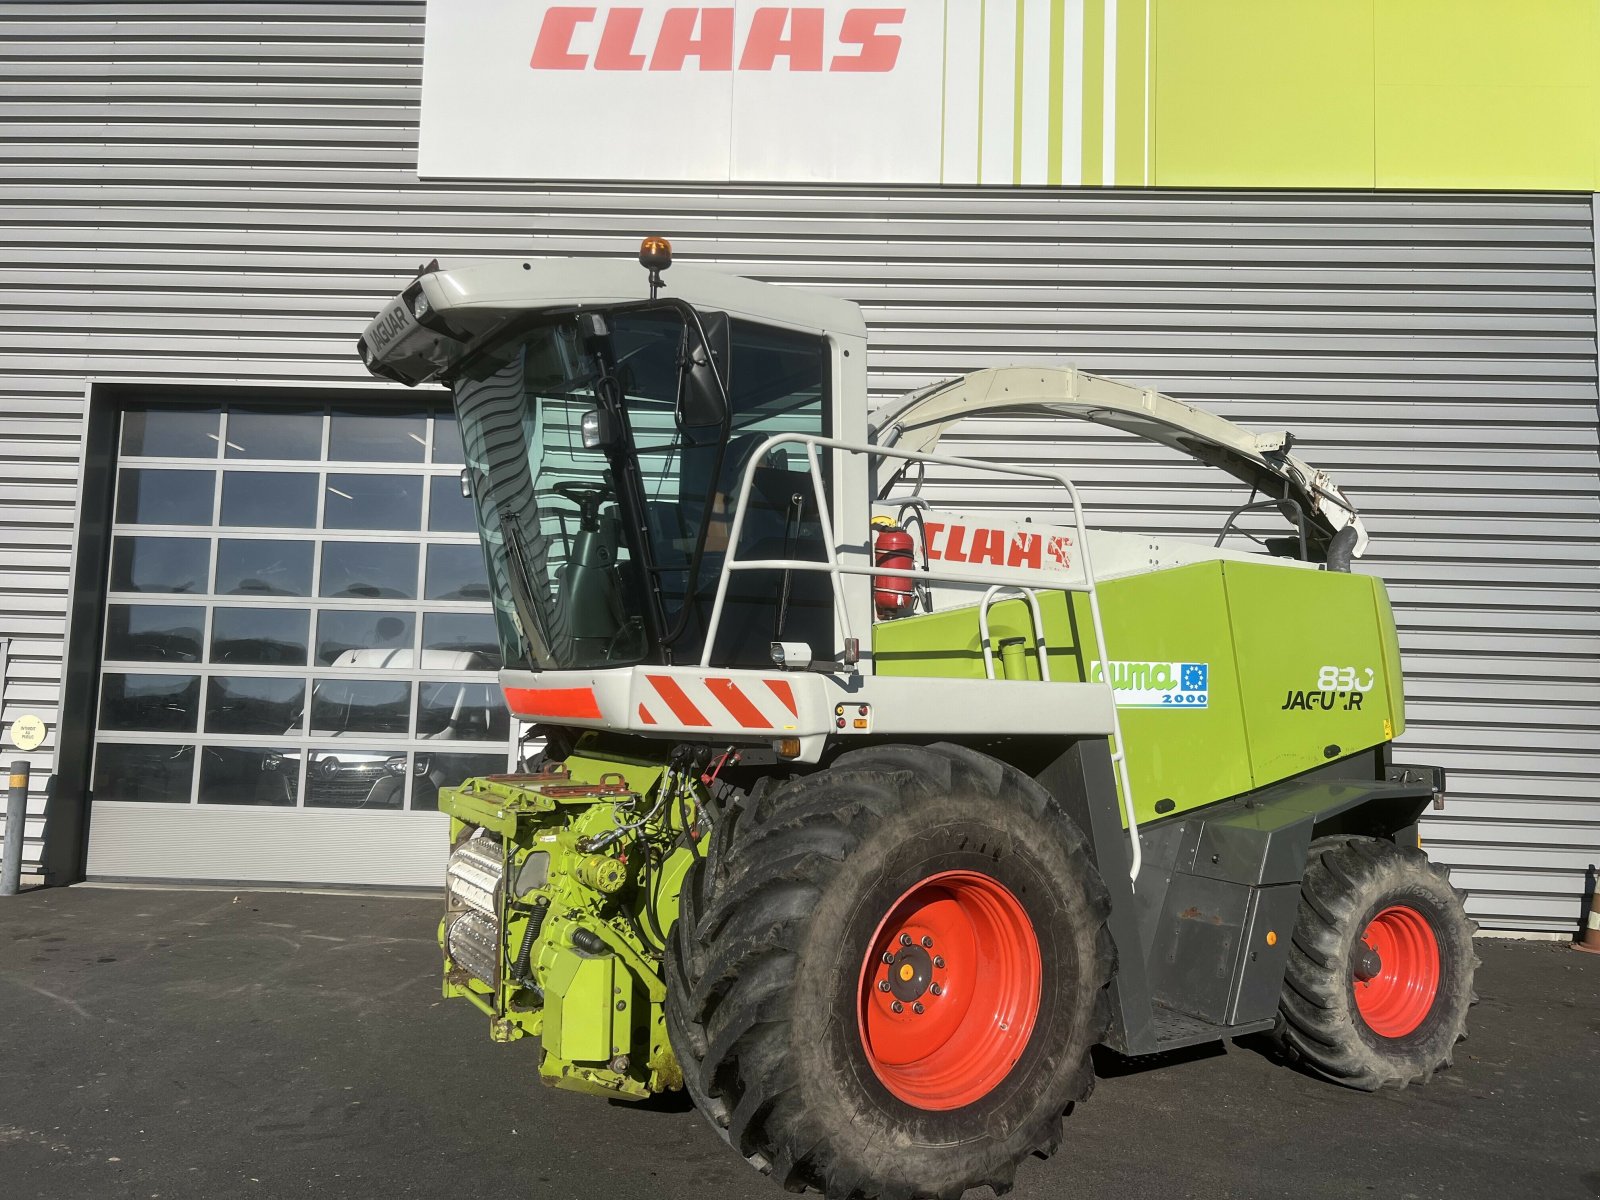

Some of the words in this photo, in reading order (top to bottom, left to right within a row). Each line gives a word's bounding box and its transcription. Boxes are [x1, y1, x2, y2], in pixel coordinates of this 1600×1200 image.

[530, 7, 906, 72] CLAAS
[369, 306, 410, 352] JAGUAR
[1317, 666, 1374, 692] 830
[1162, 694, 1207, 704] 2000
